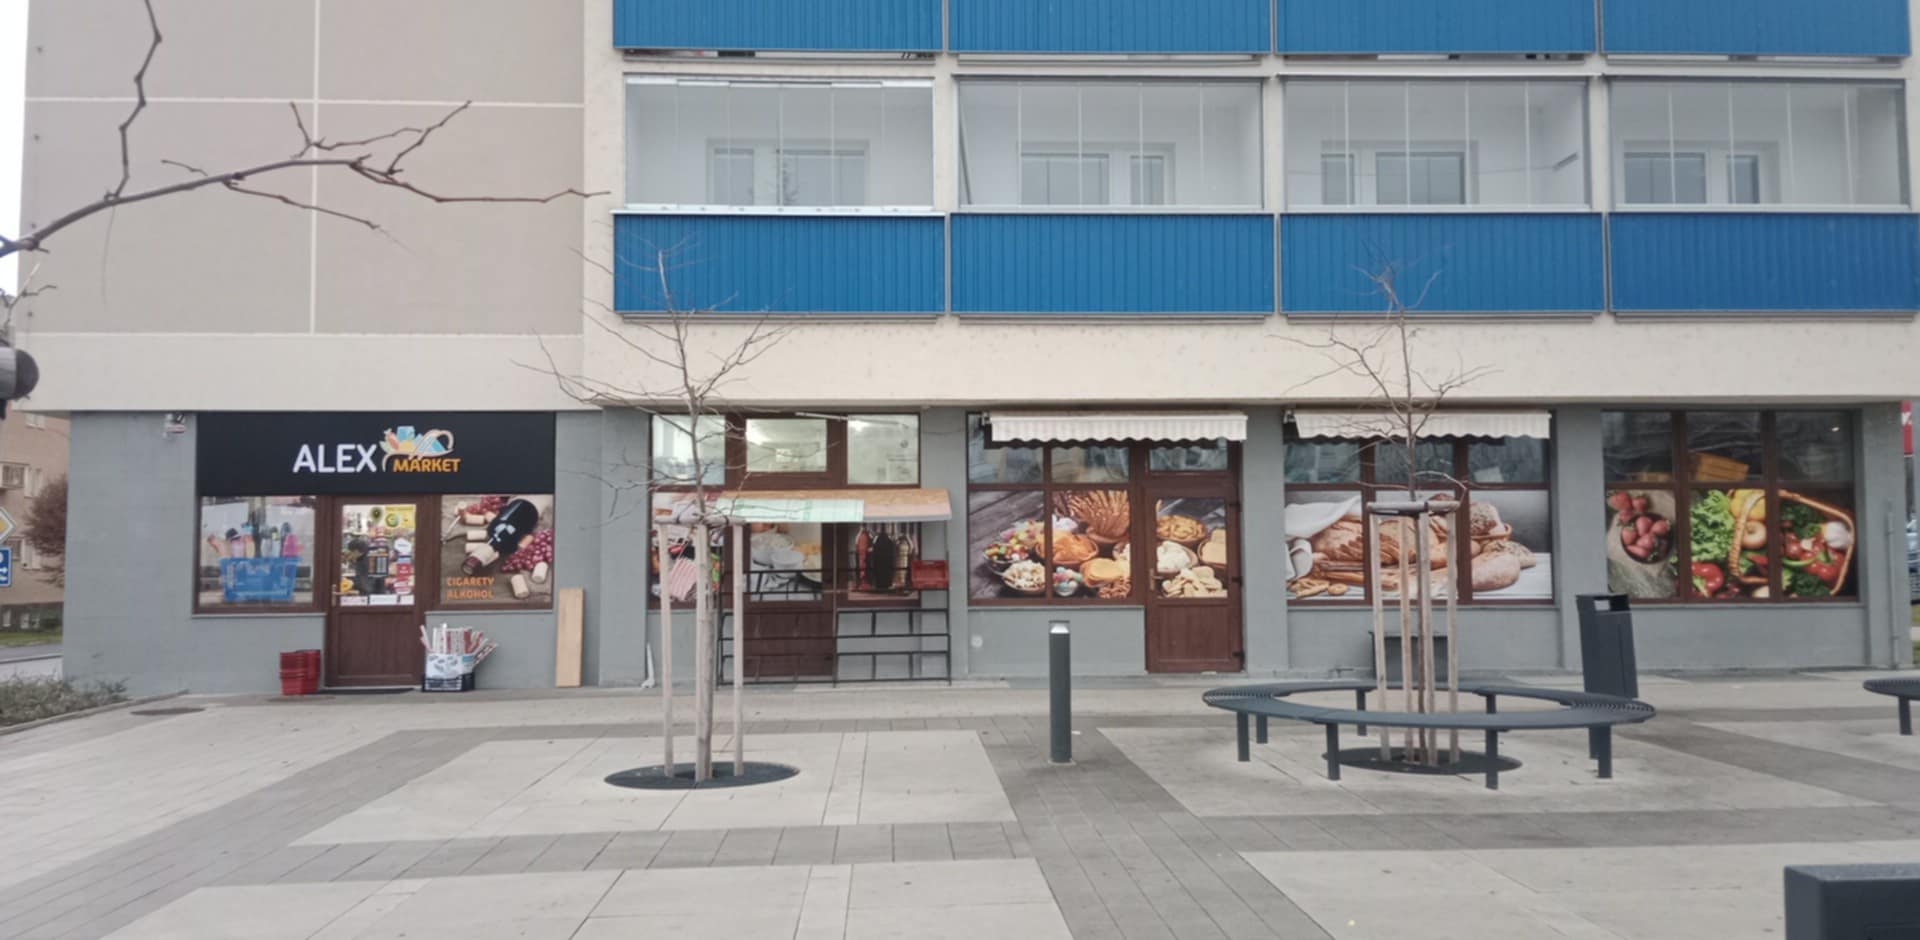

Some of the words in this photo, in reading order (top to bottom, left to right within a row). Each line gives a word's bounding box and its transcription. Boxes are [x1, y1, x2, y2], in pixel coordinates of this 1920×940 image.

[292, 444, 377, 473] ALEX
[393, 458, 461, 473] MARKET
[447, 576, 495, 586] CIGARETY
[447, 590, 494, 600] ALKOHOL
